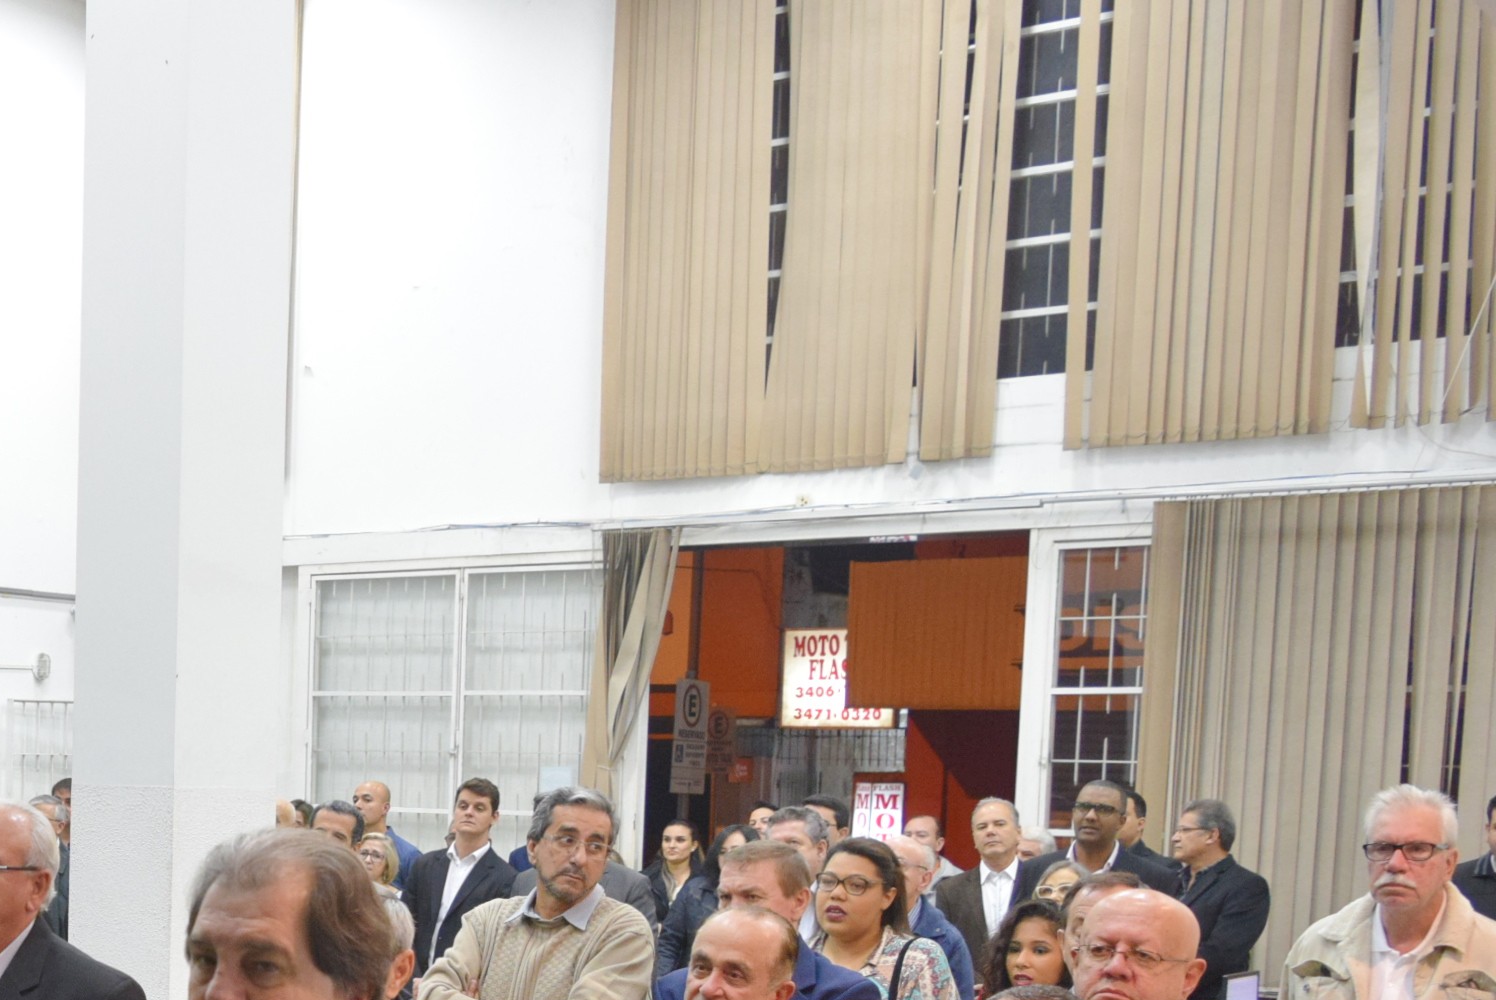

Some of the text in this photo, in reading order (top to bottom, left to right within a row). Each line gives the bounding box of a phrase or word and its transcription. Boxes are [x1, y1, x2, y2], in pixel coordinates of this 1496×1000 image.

[793, 634, 840, 658] MOTO
[808, 658, 849, 681] FLAS
[688, 694, 697, 717] E
